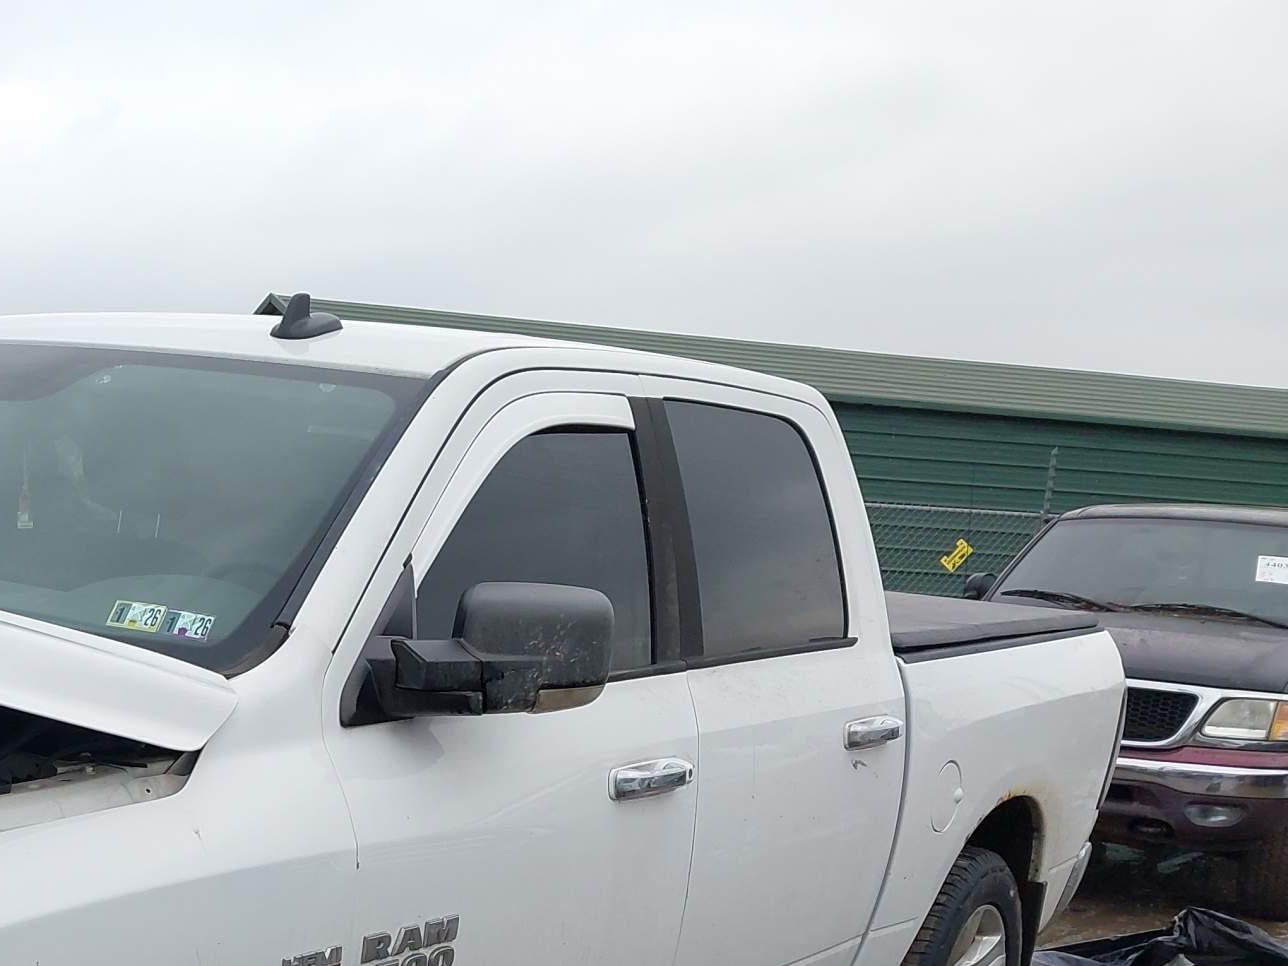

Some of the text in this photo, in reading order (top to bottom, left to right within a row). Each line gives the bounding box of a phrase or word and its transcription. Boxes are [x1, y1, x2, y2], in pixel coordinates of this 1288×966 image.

[143, 607, 161, 627] 26
[194, 616, 212, 637] 26
[360, 914, 460, 964] RAM
